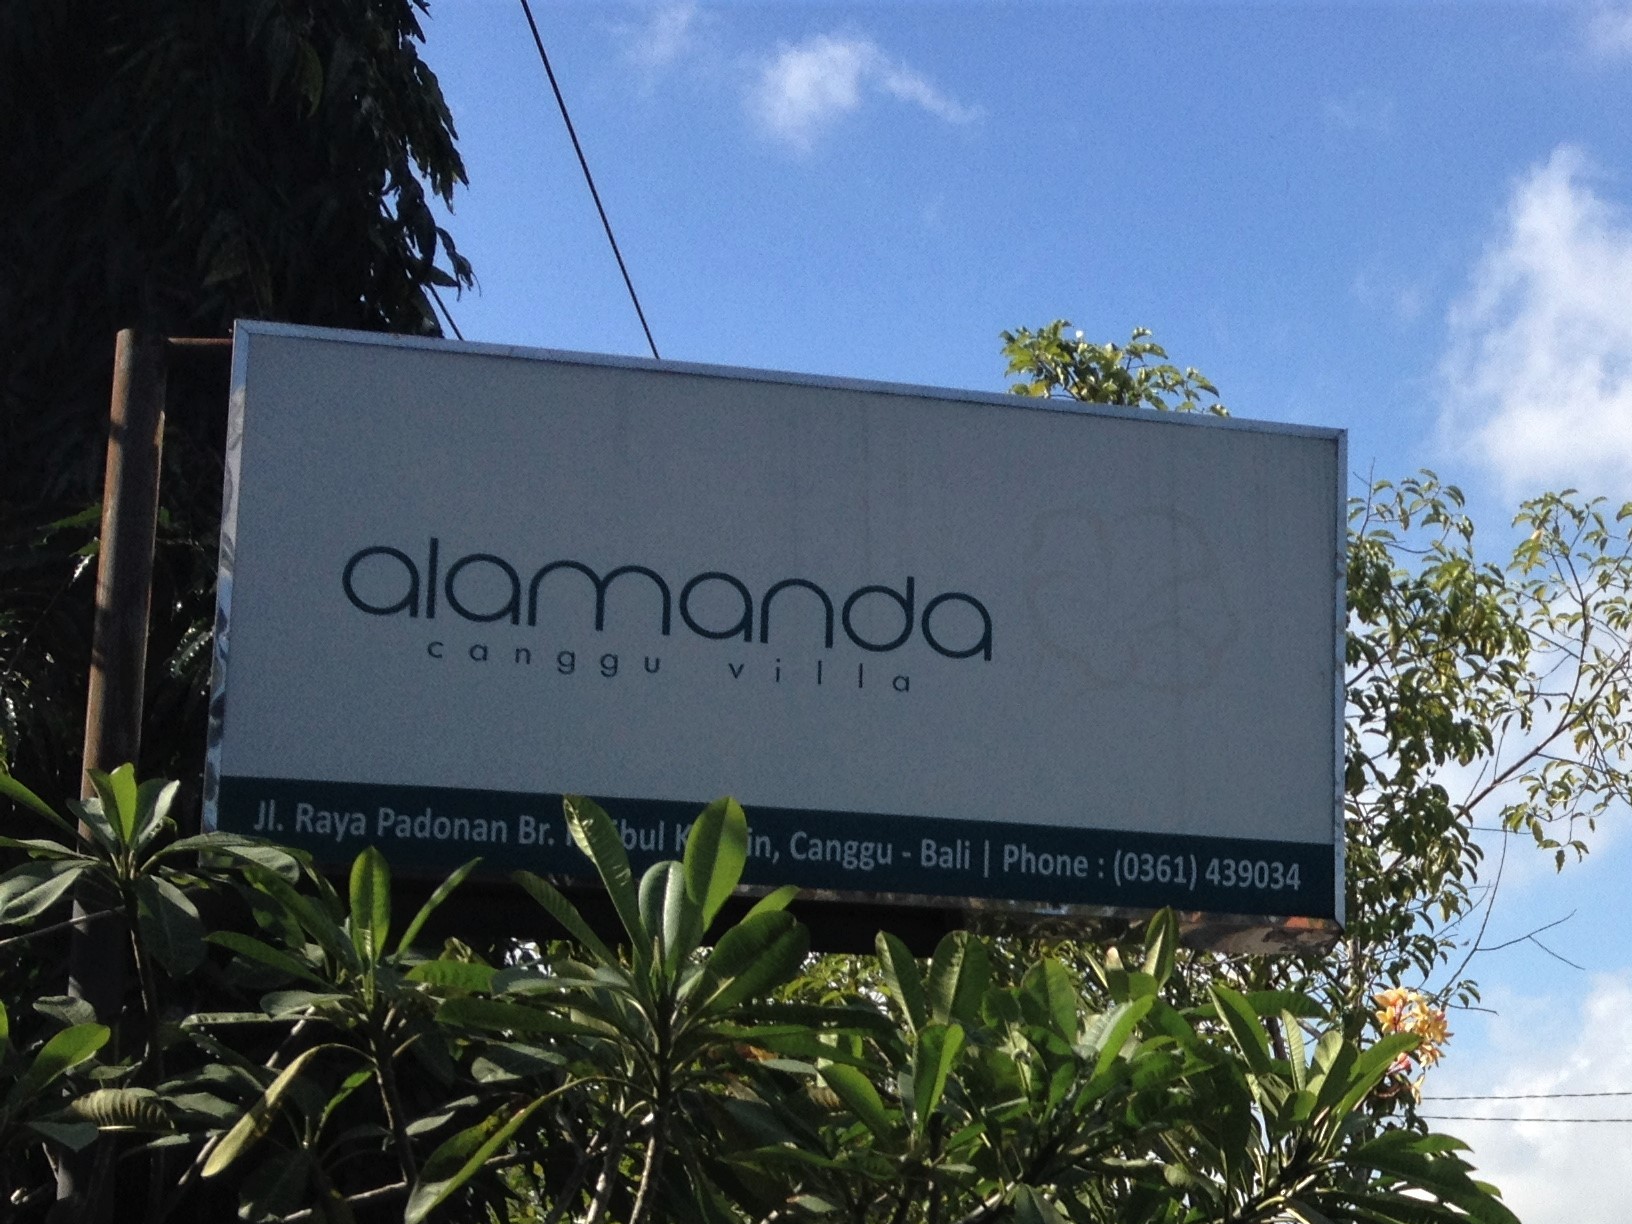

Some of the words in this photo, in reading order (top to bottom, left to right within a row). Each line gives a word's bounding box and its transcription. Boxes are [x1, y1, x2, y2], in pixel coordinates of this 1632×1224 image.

[342, 537, 992, 661] alamanda
[427, 640, 661, 677] canggu
[728, 658, 910, 692] villa
[254, 800, 283, 833] Jl.
[296, 803, 366, 843] Raya
[377, 807, 507, 845] Padonan
[519, 815, 555, 846] Br.
[790, 831, 893, 872] Canggu
[921, 838, 971, 870] Bali
[1003, 843, 1089, 878] Phone
[1113, 848, 1198, 891] (0361)
[1205, 857, 1301, 891] 439034
